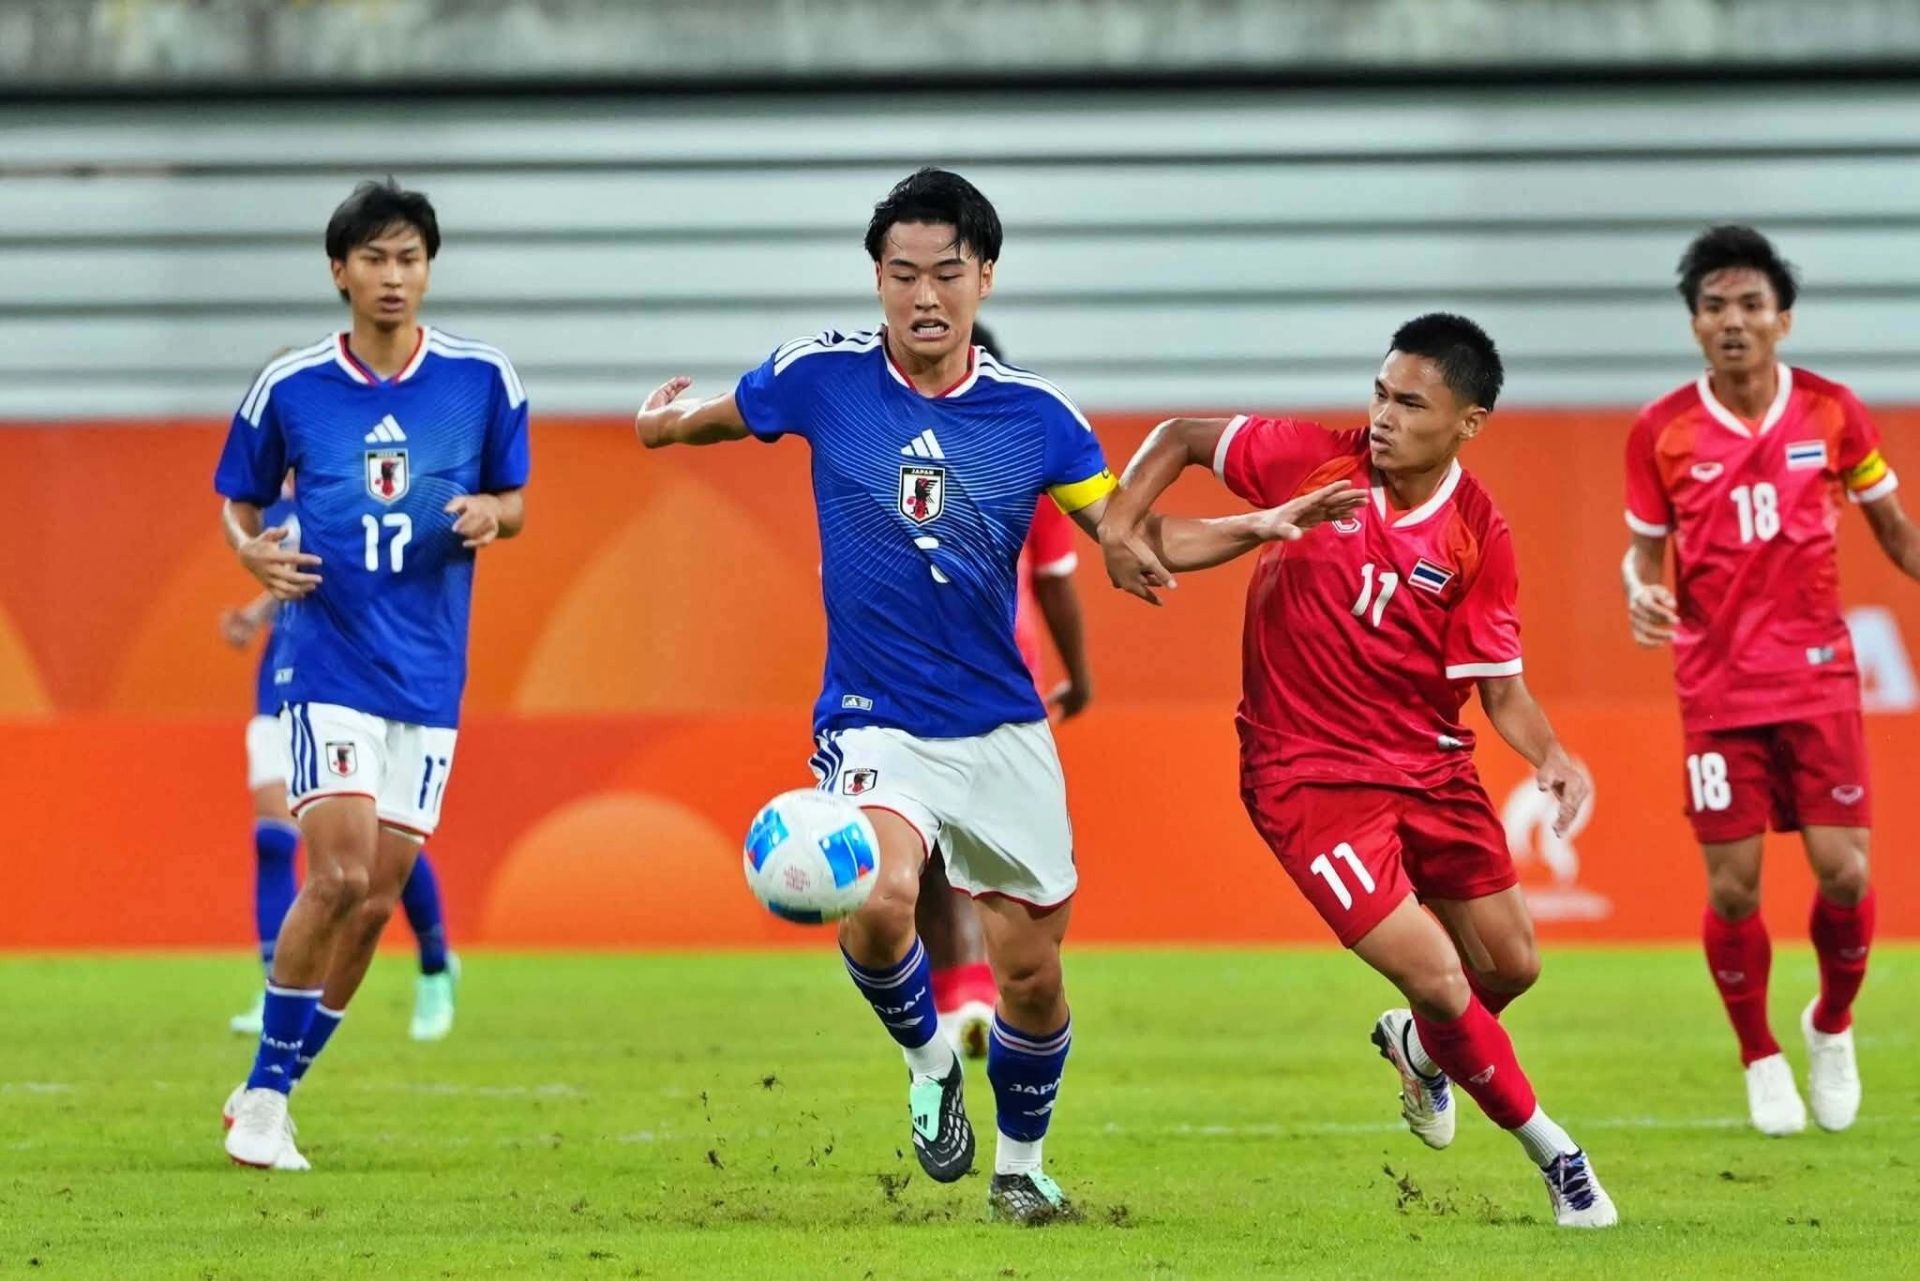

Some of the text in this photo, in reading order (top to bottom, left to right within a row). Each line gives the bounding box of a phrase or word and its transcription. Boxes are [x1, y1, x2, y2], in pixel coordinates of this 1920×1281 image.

[362, 513, 412, 573] 17
[1730, 482, 1780, 543] 18
[1352, 563, 1398, 627] 11
[1687, 752, 1732, 812] 18
[1310, 842, 1375, 911] 11
